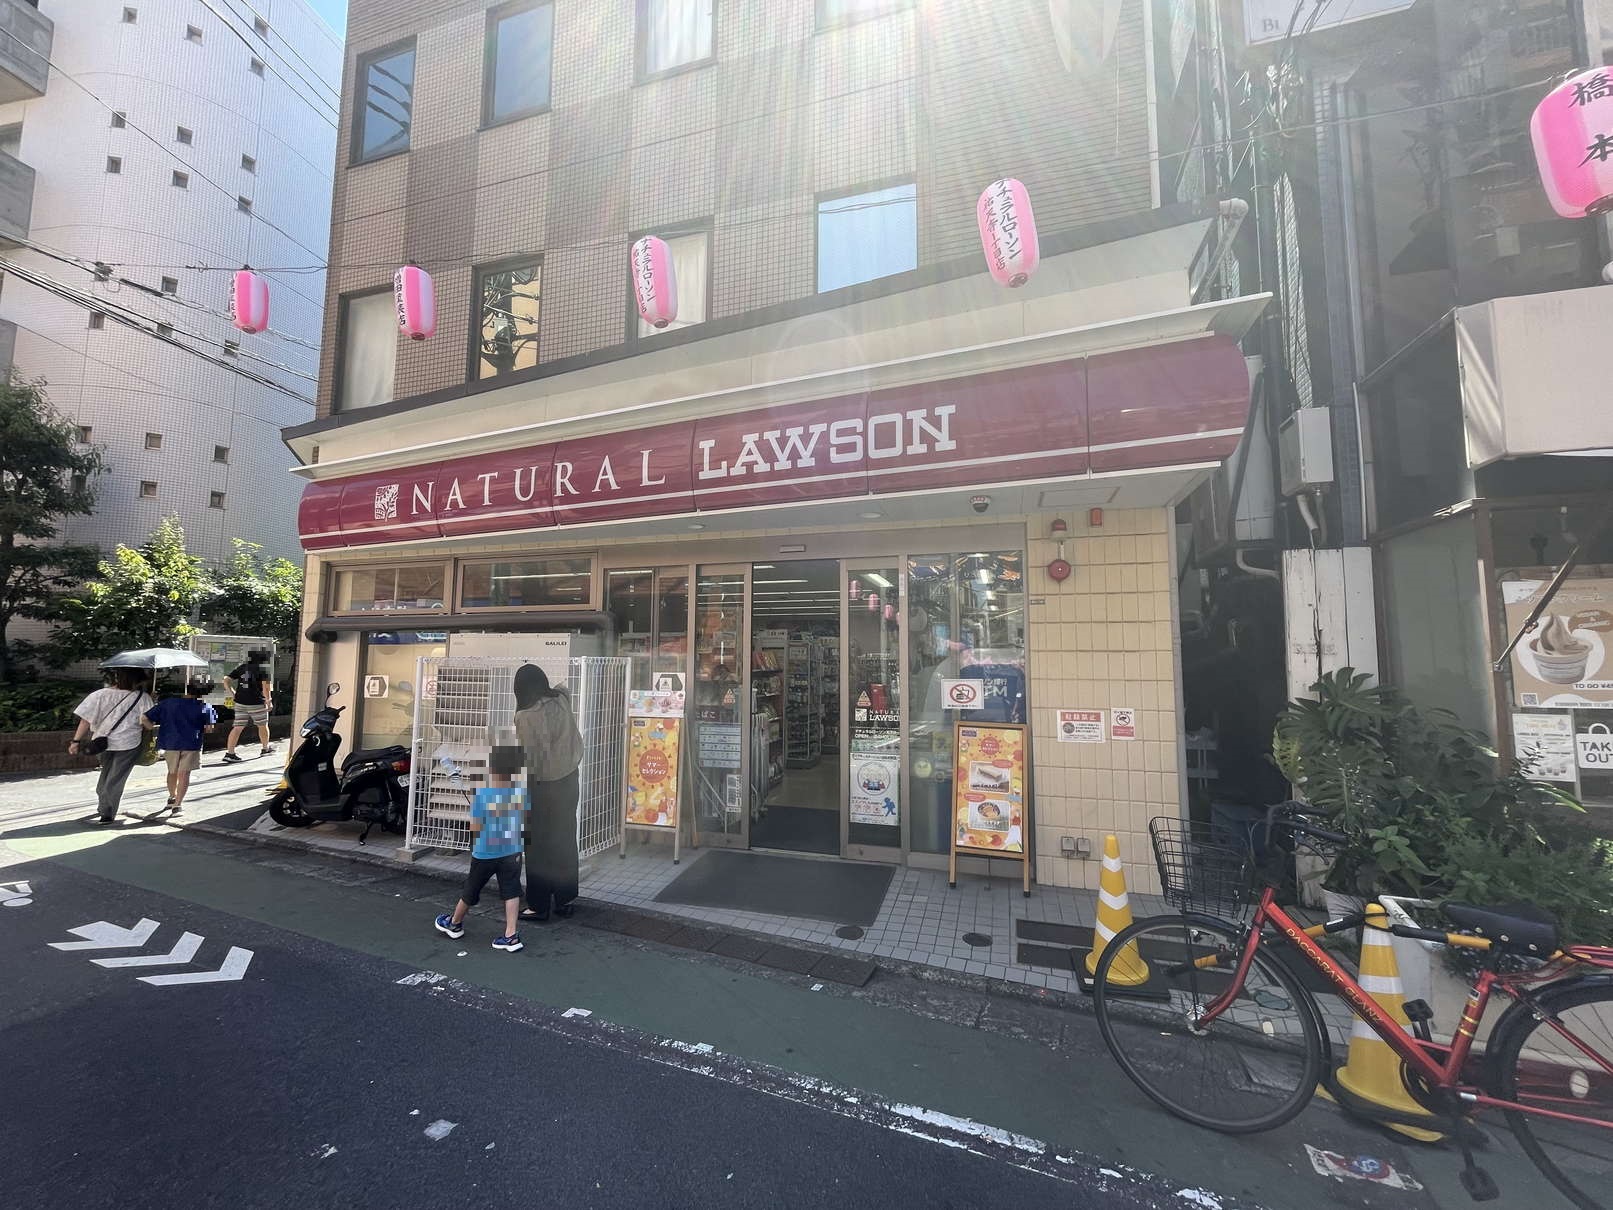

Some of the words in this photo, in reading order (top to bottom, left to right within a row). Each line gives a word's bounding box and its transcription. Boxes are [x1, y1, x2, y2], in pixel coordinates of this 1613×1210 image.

[996, 179, 1022, 260] ナチュラルローソン
[410, 448, 666, 515] NATURAL
[698, 404, 957, 481] LAWSON
[1579, 741, 1612, 752] TAK
[1585, 752, 1613, 764] OU
[641, 767, 667, 776] セレクション
